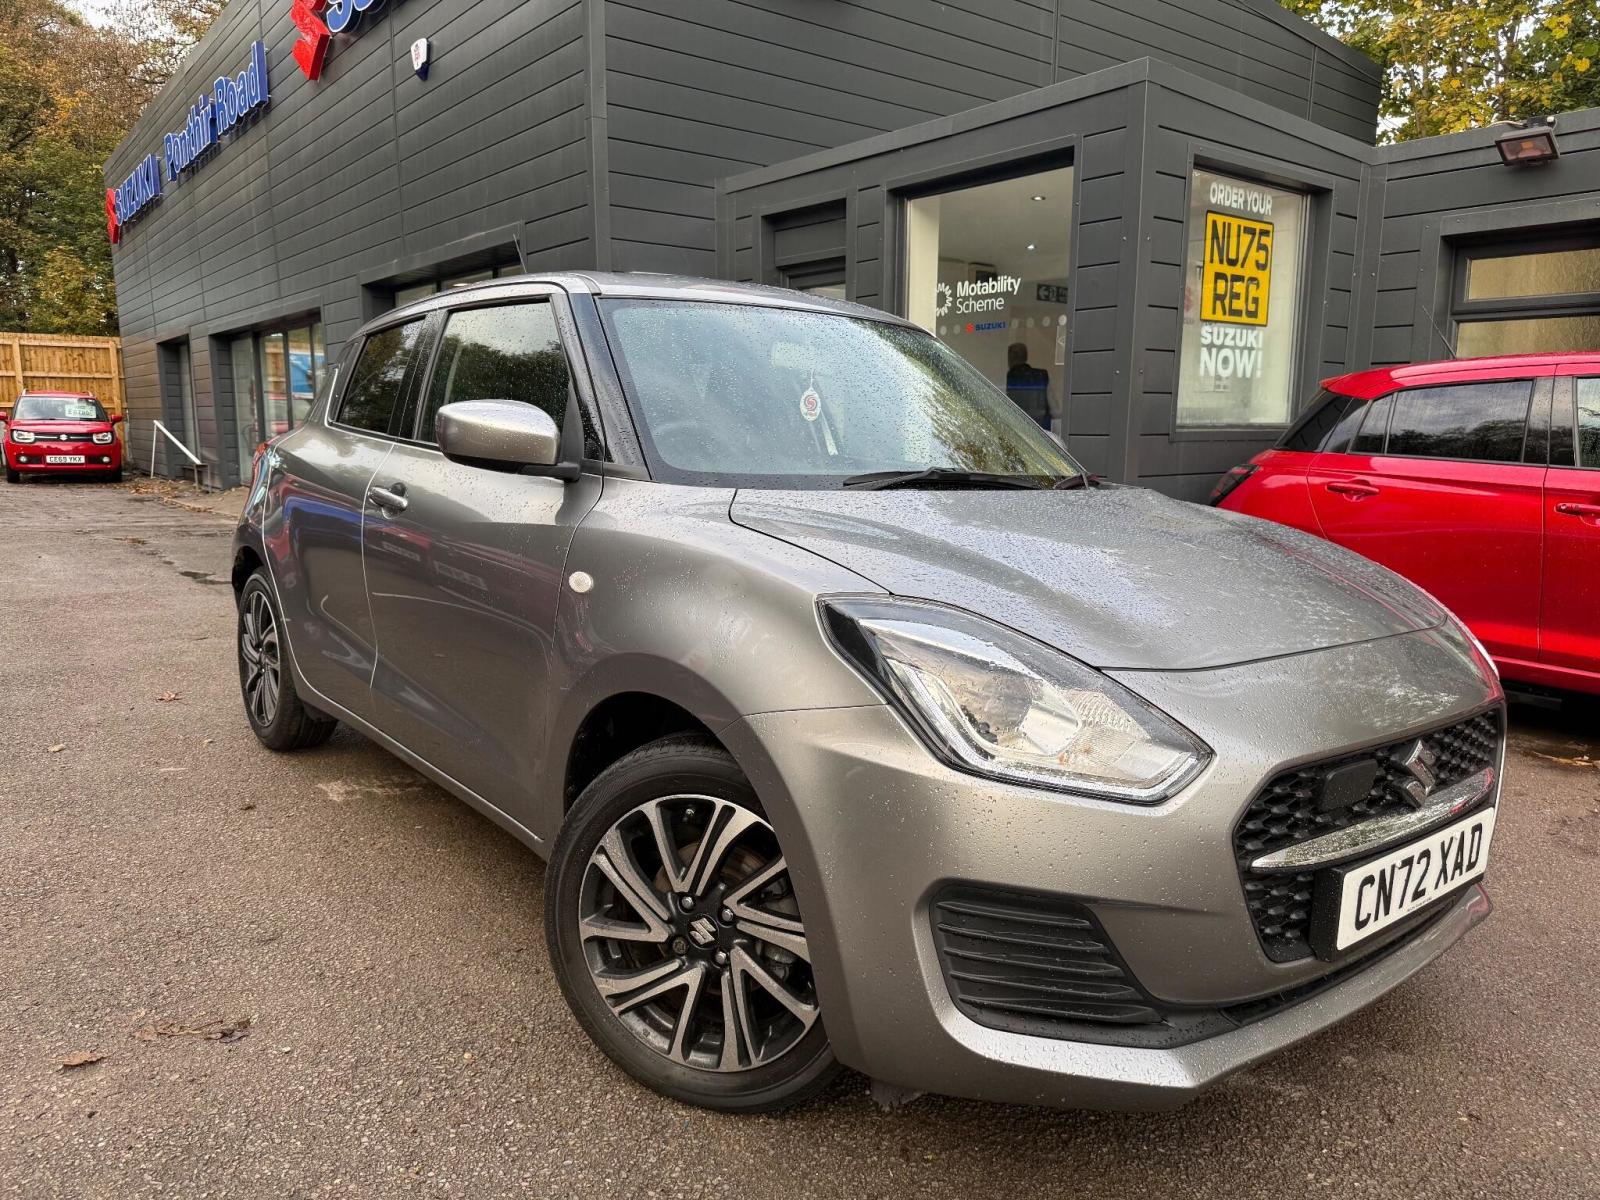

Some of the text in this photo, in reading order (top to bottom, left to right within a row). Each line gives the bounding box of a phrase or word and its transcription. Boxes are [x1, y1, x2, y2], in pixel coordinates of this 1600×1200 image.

[115, 41, 267, 226] SUZUKI Ponthir Road
[1209, 182, 1273, 215] ORDER YOUR
[1209, 219, 1271, 273] NU75
[956, 275, 1021, 297] Motability
[1212, 271, 1261, 319] REG
[956, 297, 1005, 314] Scheme
[975, 321, 1006, 331] SUZUKI
[1201, 325, 1264, 348] SUZUKI
[1200, 347, 1264, 378] NOW!
[1354, 822, 1483, 931] CN72 XAD
